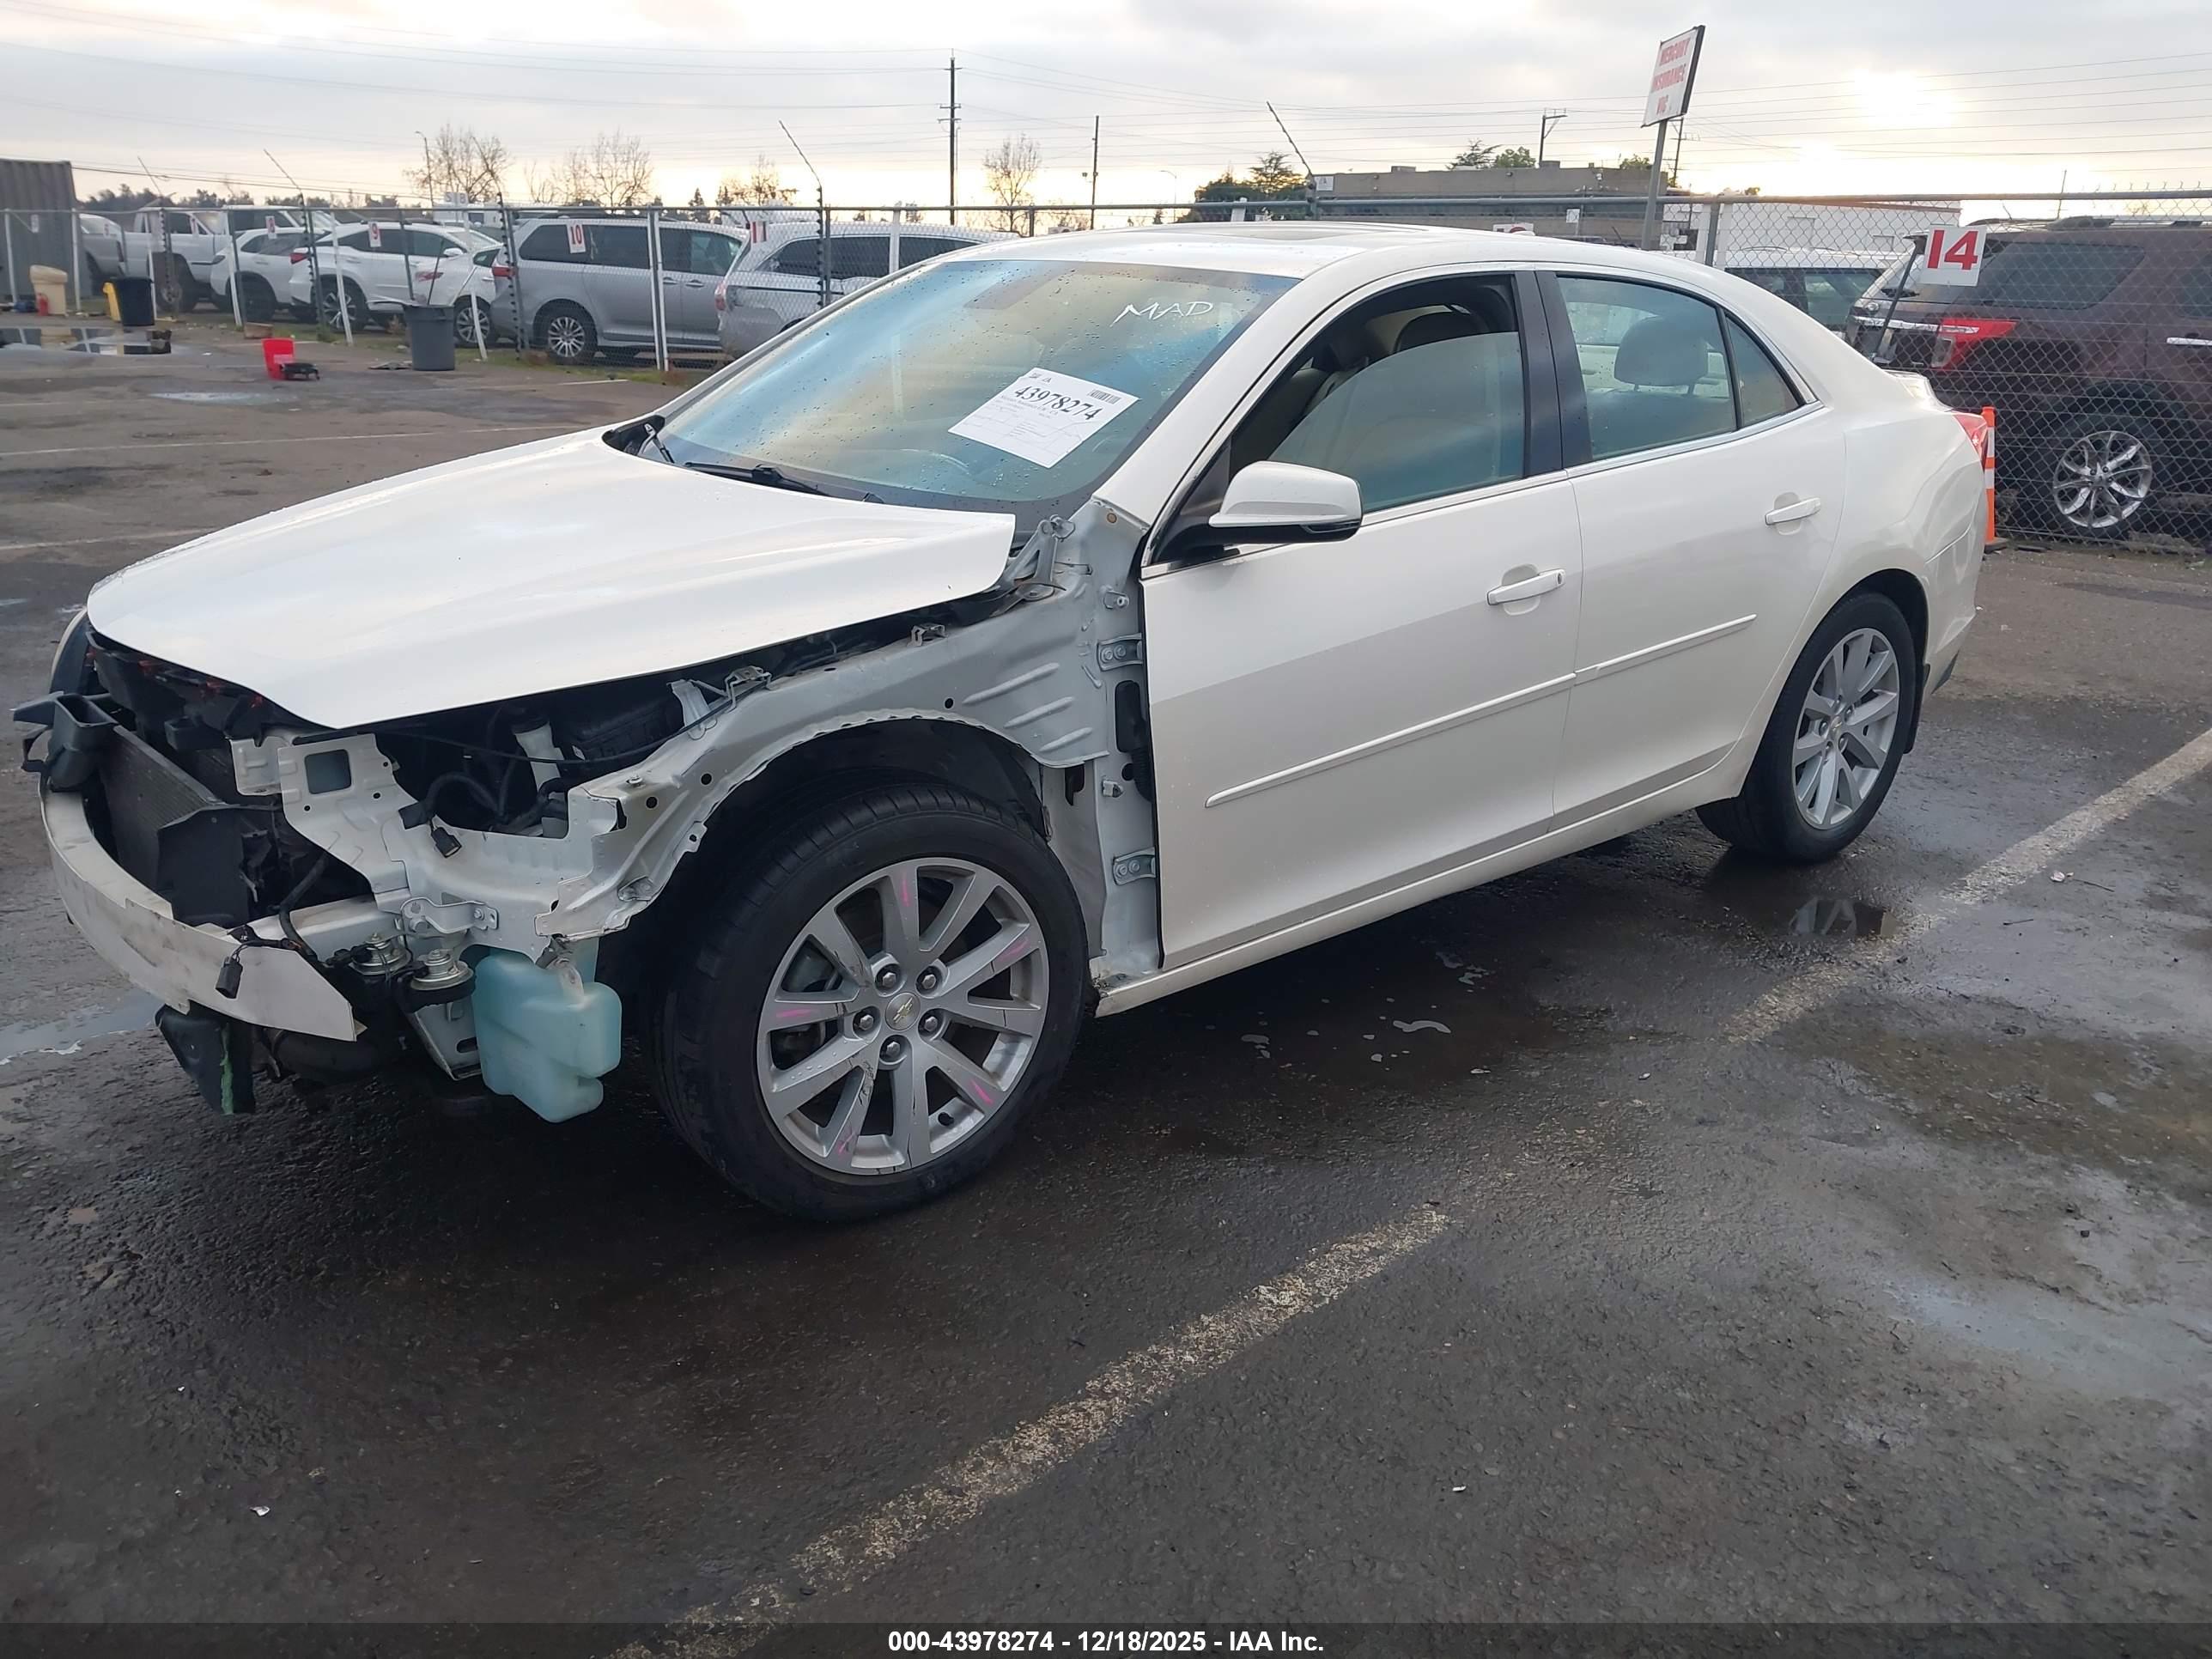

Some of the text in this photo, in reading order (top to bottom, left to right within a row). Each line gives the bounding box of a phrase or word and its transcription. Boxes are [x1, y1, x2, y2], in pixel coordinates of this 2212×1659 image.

[371, 222, 380, 240] 9
[570, 224, 583, 245] 10
[752, 221, 767, 244] 11
[1927, 229, 1979, 270] 14
[1109, 301, 1214, 327] MAD
[1014, 385, 1104, 421] 43978274
